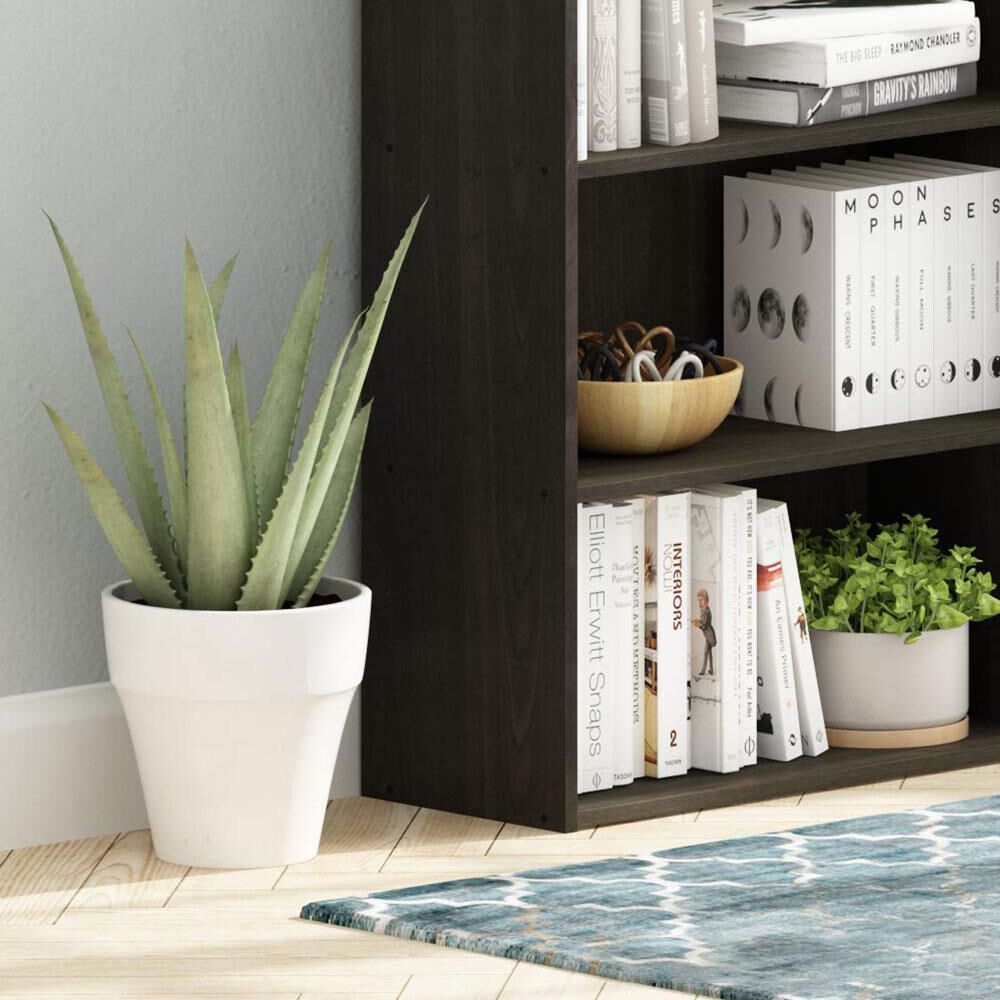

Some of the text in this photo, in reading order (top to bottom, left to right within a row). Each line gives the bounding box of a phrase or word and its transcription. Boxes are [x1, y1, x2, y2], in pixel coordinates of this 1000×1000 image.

[850, 50, 862, 63] BIG
[891, 38, 924, 54] RAYMOND
[927, 32, 960, 49] CHANDLER
[874, 67, 958, 106] GRAVITY'S RAINBOW
[672, 543, 682, 631] INTERIORS
[586, 513, 606, 757] Elliott Erwitt Snaps
[669, 729, 678, 747] 2
